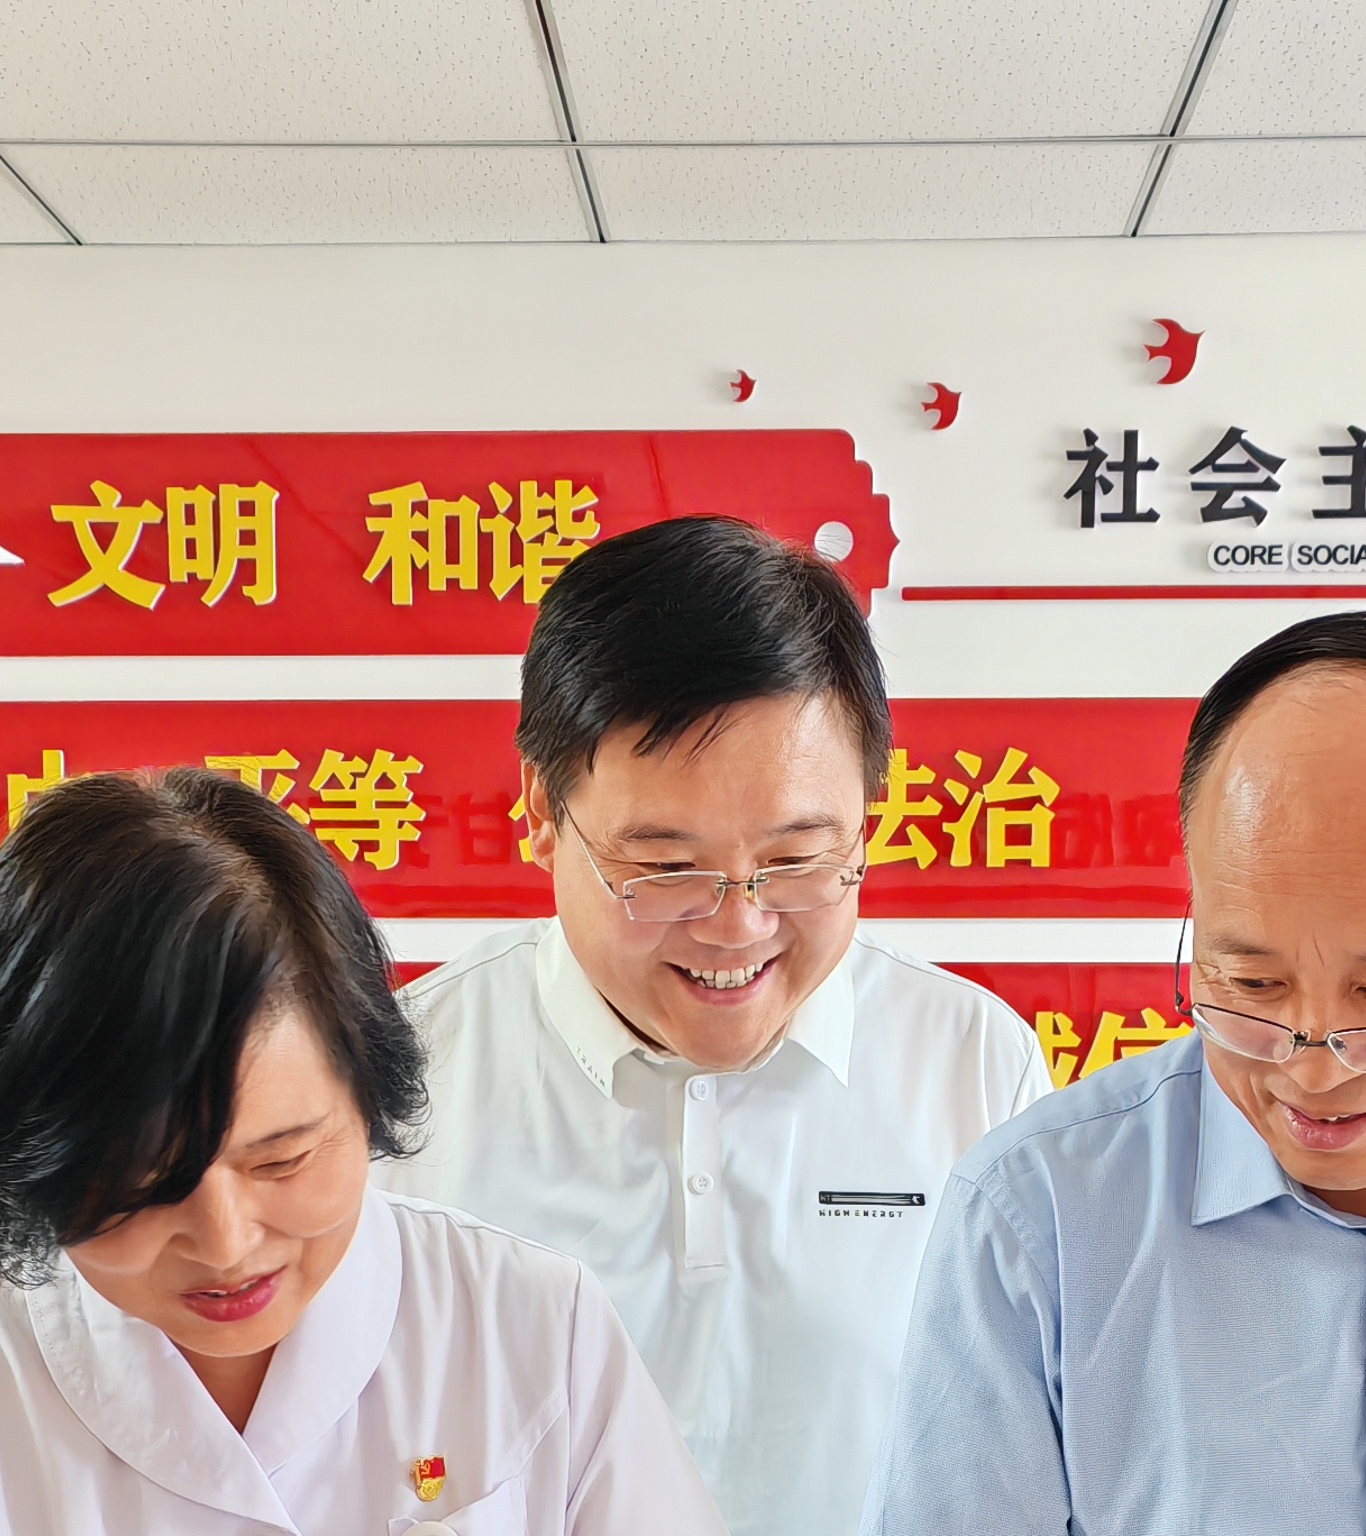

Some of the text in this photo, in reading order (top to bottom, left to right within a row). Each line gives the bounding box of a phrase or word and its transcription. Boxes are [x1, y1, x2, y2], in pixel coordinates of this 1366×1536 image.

[48, 480, 279, 608] 文明
[363, 480, 600, 606] 和谐
[1213, 544, 1283, 566] CORE
[866, 747, 1061, 870] 法治
